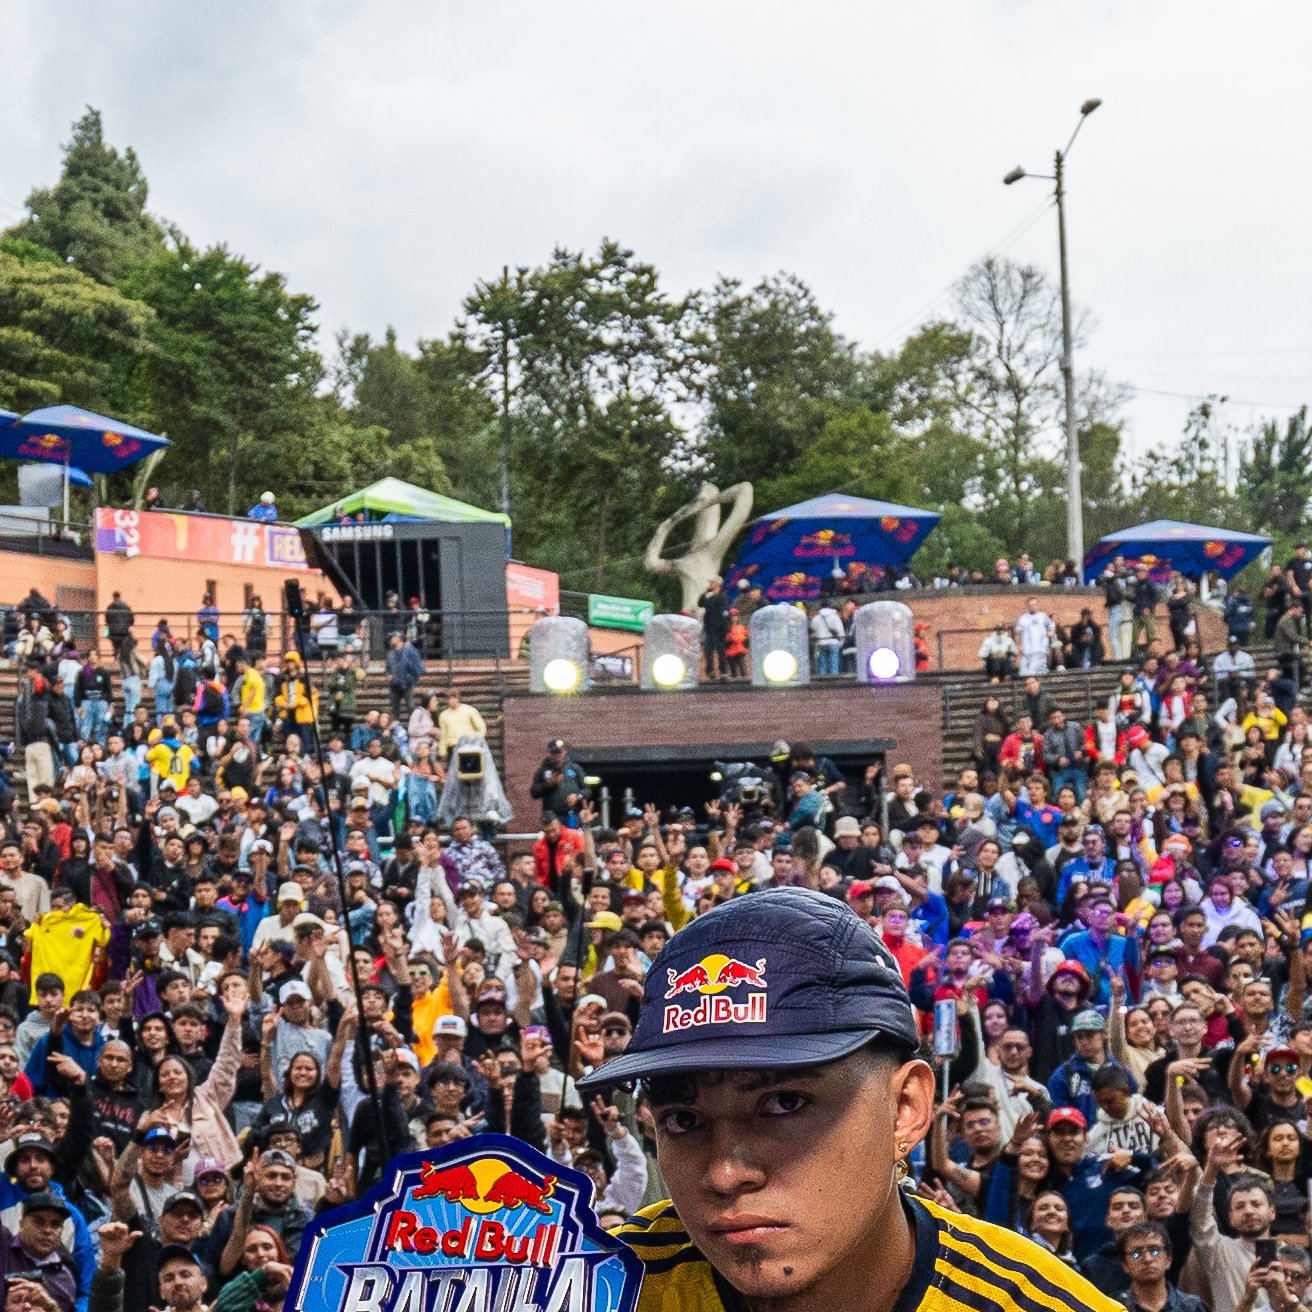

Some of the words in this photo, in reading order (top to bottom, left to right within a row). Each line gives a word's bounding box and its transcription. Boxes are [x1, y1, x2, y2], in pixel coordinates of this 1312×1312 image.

[321, 524, 394, 542] SAMSUNG
[664, 996, 708, 1032] Red
[712, 995, 766, 1022] Bull
[387, 1210, 475, 1260] Red
[475, 1220, 561, 1267] Bull
